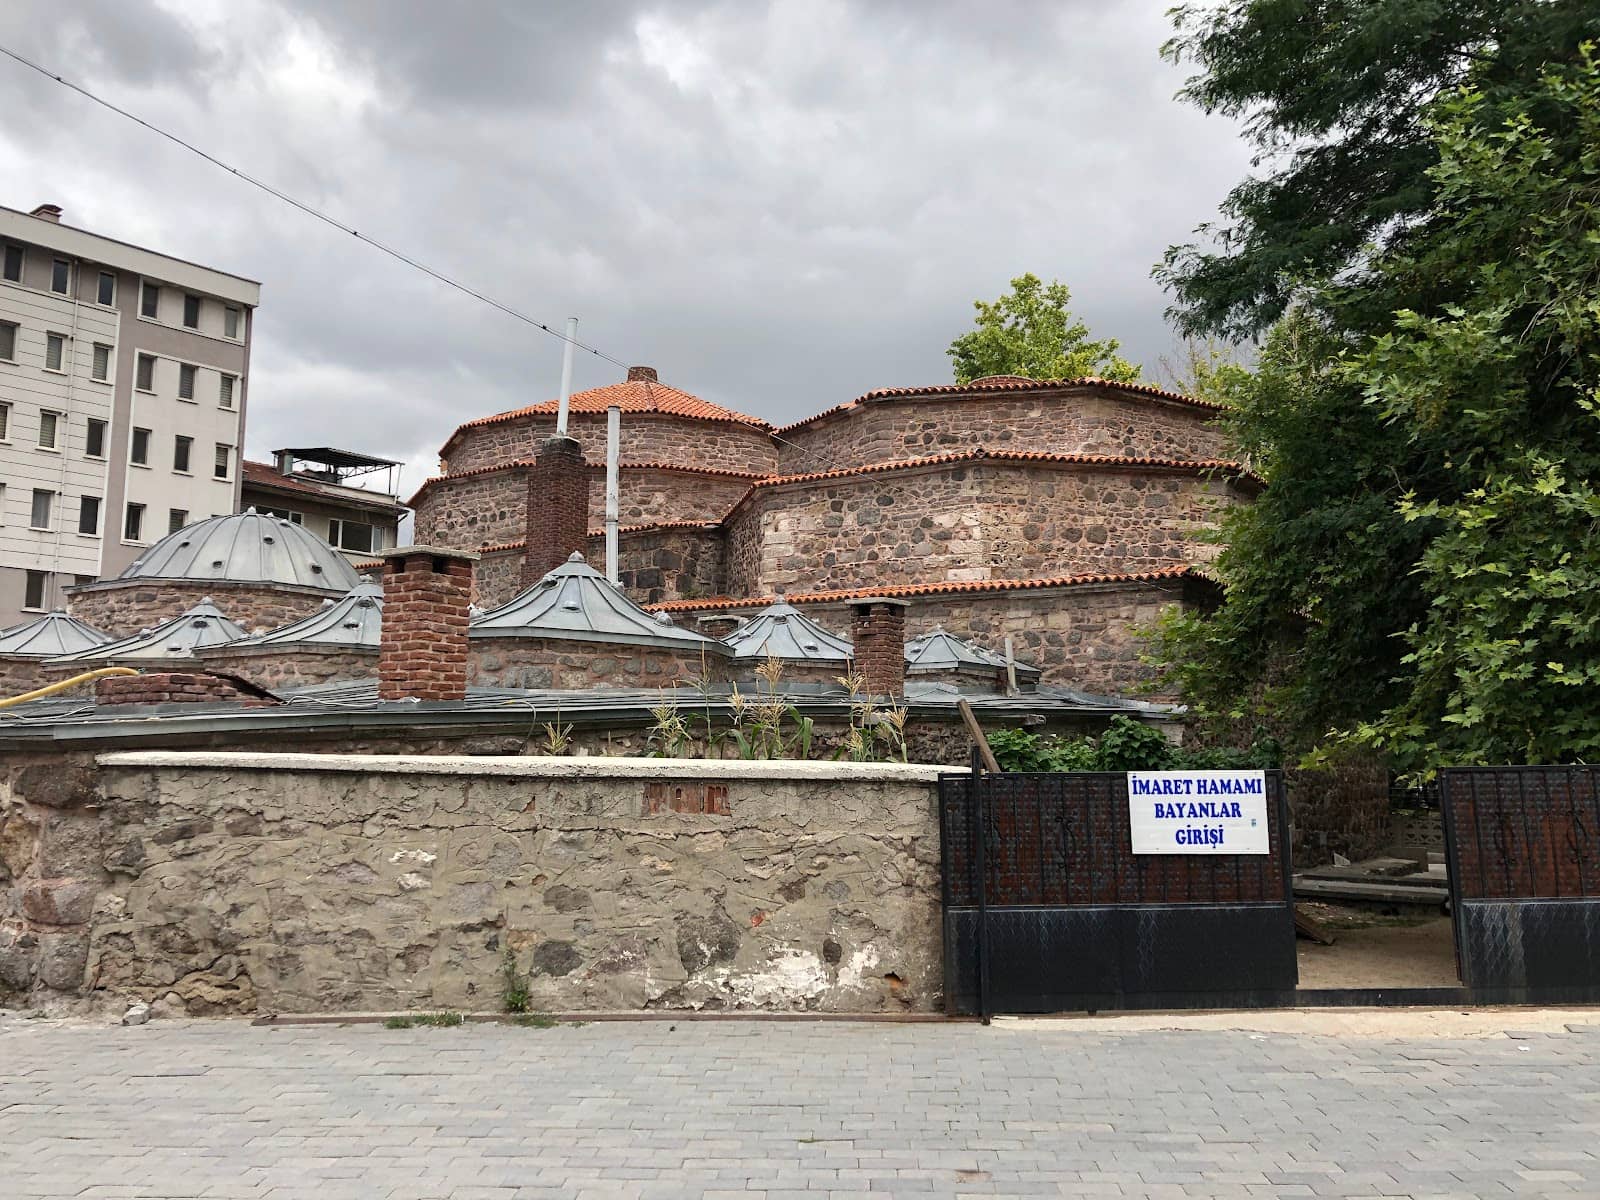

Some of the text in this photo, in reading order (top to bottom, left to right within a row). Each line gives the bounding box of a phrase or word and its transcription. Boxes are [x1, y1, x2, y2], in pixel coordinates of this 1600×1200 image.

[1132, 775, 1262, 795] İMARET HAMAMI
[1154, 802, 1242, 818] BAYANLAR
[1175, 824, 1224, 848] GİRİŞİ
